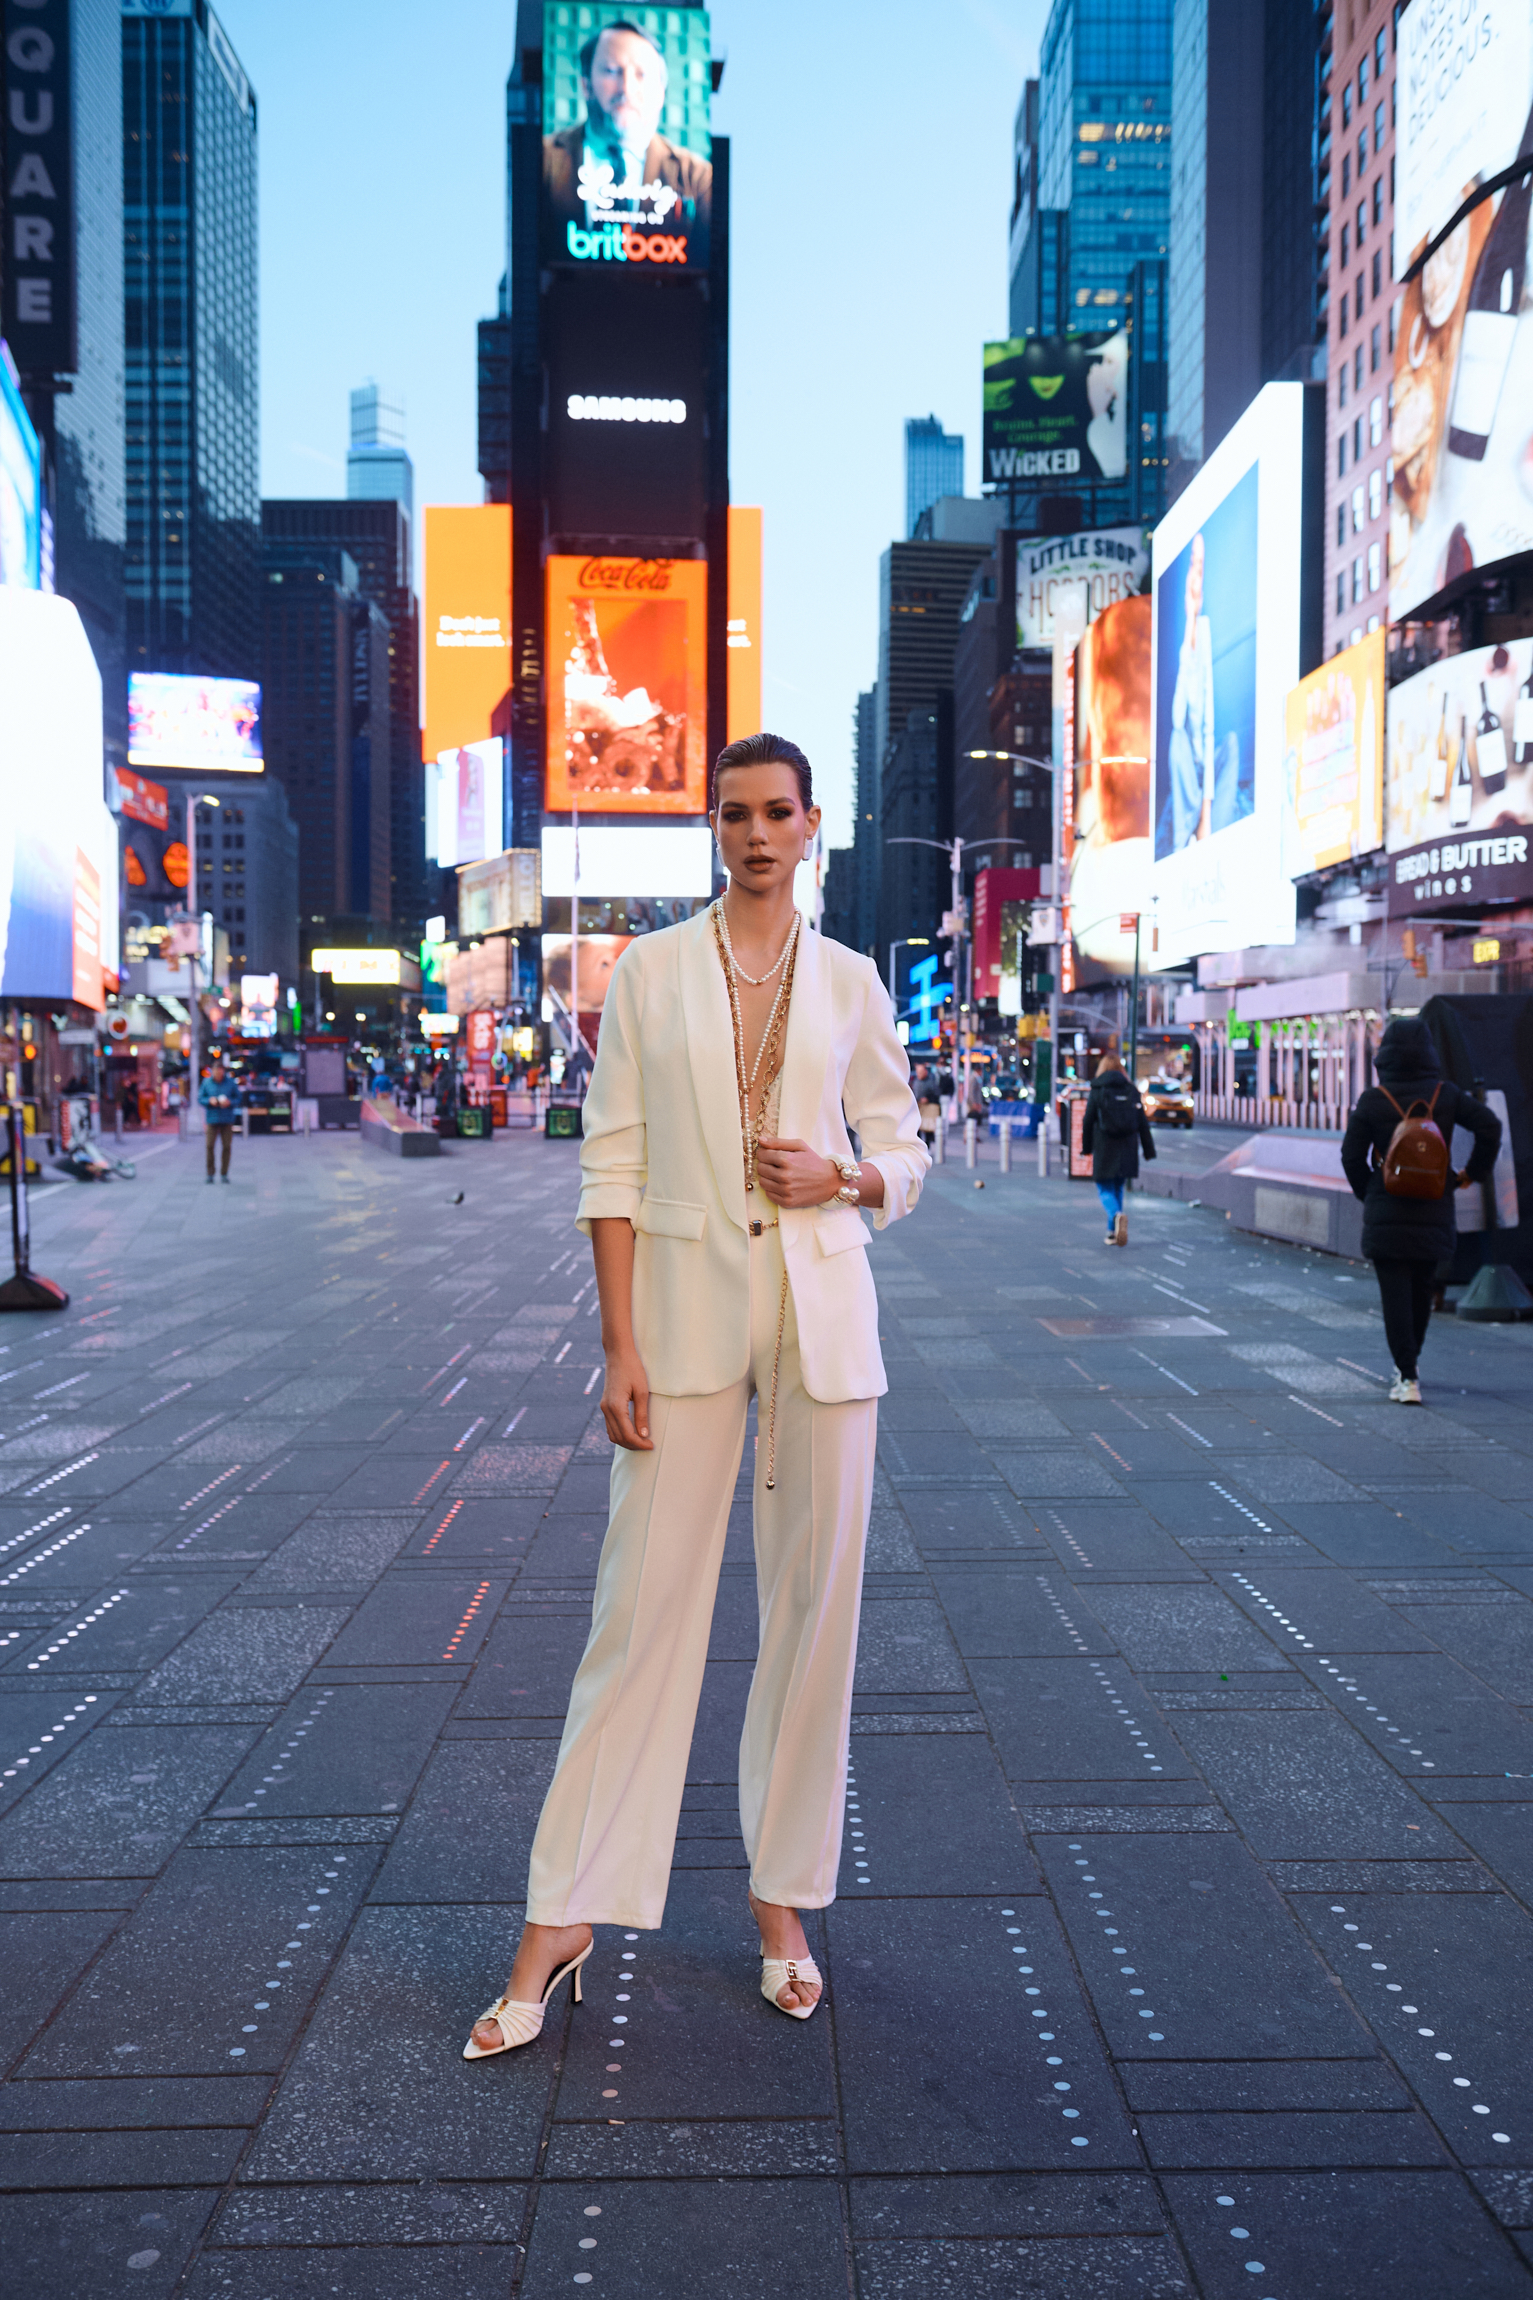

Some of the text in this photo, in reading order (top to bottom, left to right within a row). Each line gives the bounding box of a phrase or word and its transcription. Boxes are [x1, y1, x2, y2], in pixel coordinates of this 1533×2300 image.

[6, 0, 57, 324] QUARE
[567, 220, 688, 264] britbox
[1030, 538, 1137, 575] LITTLE SHOP
[1441, 835, 1529, 872] BUTTER
[1414, 875, 1472, 901] wines
